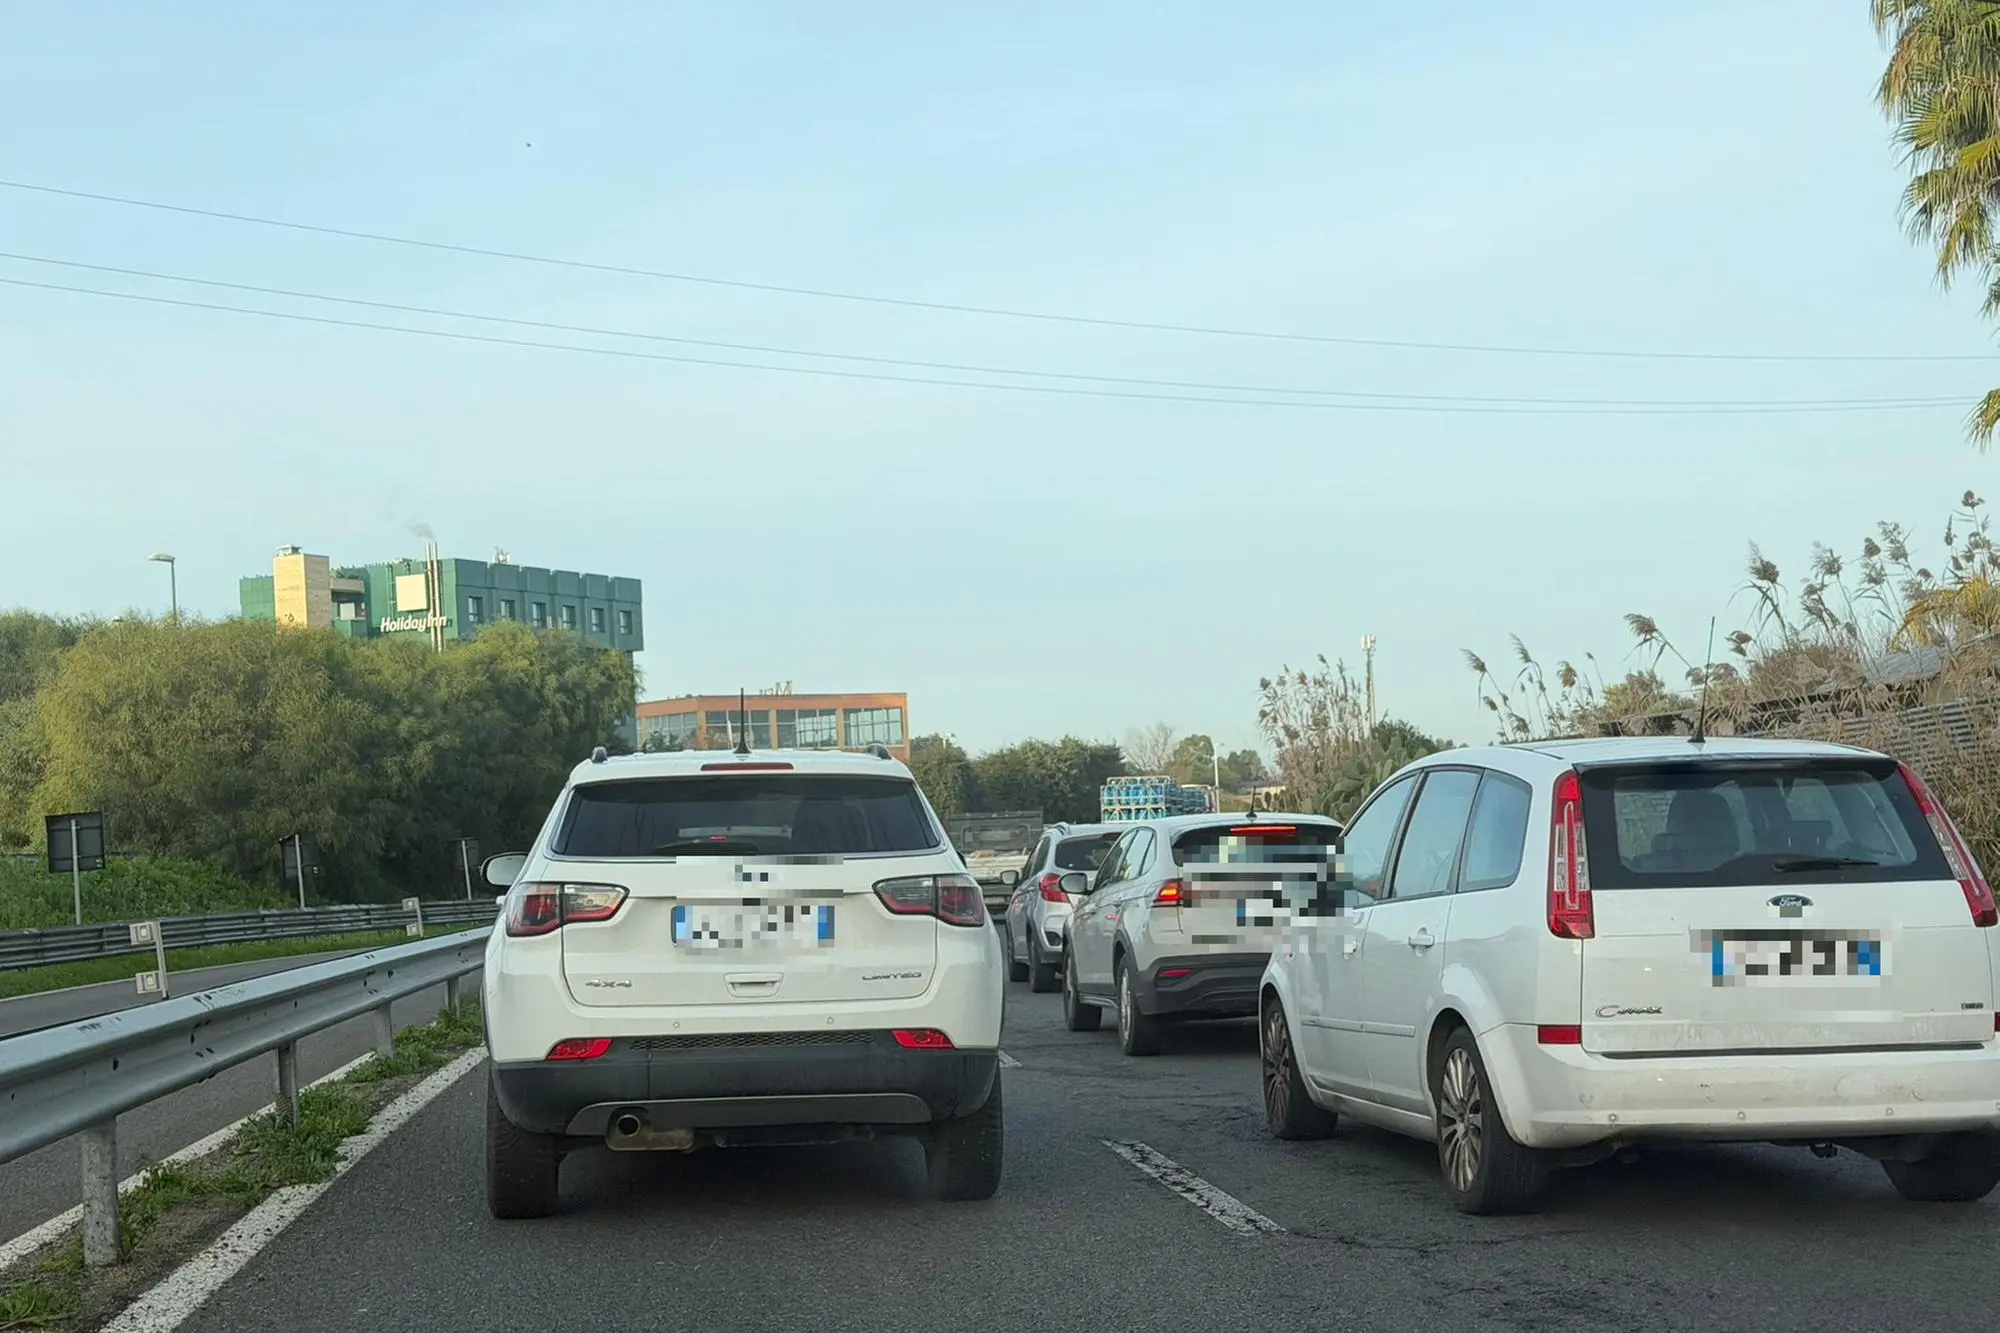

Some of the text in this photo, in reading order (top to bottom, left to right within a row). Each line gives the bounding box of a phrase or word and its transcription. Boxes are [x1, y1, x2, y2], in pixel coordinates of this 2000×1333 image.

[380, 609, 447, 633] Holiday Inn
[1779, 896, 1803, 907] Ford
[862, 971, 922, 981] LIMITED
